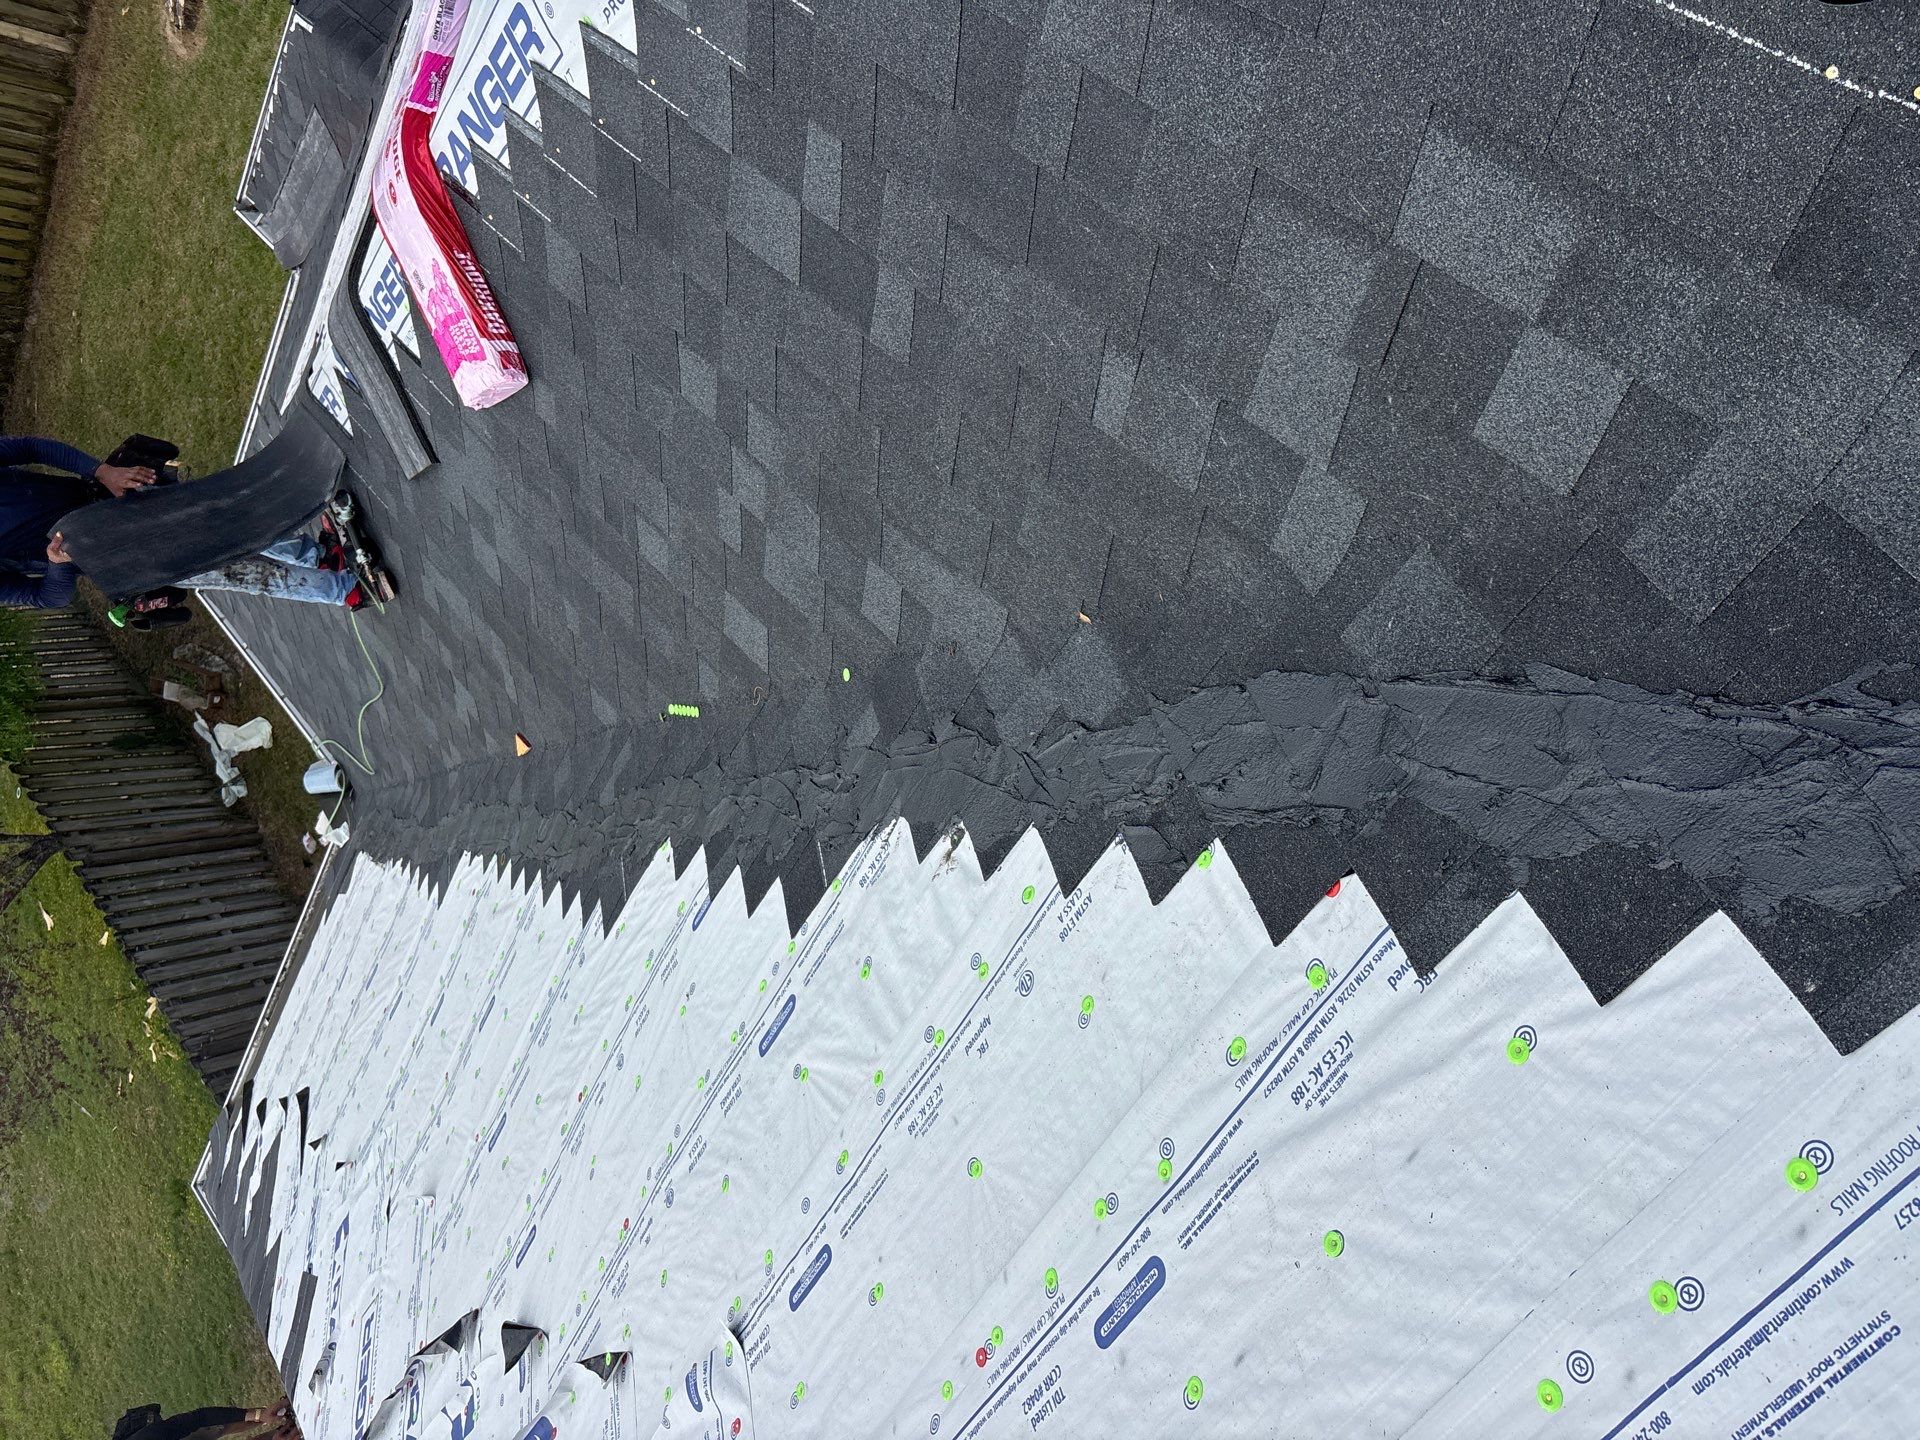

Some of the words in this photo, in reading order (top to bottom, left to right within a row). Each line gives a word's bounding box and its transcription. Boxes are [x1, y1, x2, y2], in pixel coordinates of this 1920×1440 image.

[435, 0, 445, 18] BLAC
[431, 19, 441, 40] ONYX
[1062, 887, 1083, 916] CLASS
[1073, 892, 1094, 921] ASTM
[1026, 910, 1048, 940] conditions
[1057, 912, 1065, 923] A
[1057, 916, 1076, 943] E108
[1371, 934, 1396, 967] Meets
[1353, 959, 1375, 988] ASTM
[1387, 955, 1415, 991] oved
[1298, 995, 1314, 1017] CAP
[1335, 980, 1357, 1008] D226,
[1279, 1009, 1302, 1039] NAILS
[1318, 1001, 1339, 1029] ASTM
[962, 1013, 992, 1055] Approved
[975, 1038, 989, 1059] FBC
[1300, 1023, 1322, 1051] D4869
[1248, 1035, 1279, 1073] ROOFING
[1321, 1028, 1354, 1070] ICC-ES
[1233, 1065, 1253, 1092] NAILS
[1279, 1051, 1299, 1077] ASTM
[1311, 1048, 1353, 1101] REQUIREMENTS
[923, 1081, 943, 1110] ICC-ES
[1261, 1071, 1283, 1099] D8257
[1289, 1061, 1325, 1107] AC-188
[1329, 1069, 1348, 1094] MEETS
[1303, 1096, 1314, 1111] OF
[1317, 1089, 1332, 1108] THE
[905, 1106, 927, 1136] AC-188
[1161, 1116, 1245, 1218] www.continentalmaterials.com
[1226, 1147, 1257, 1185] SYNTHETIC
[1859, 1131, 1920, 1189] ROOFING
[1212, 1180, 1229, 1202] ROOF
[1220, 1156, 1259, 1204] CONTINENTAL
[1825, 1175, 1870, 1218] NAILS
[1175, 1196, 1215, 1245] UNDERLAYMENT
[1190, 1200, 1222, 1239] MATERIALS,
[1889, 1195, 1920, 1231] 8257
[1114, 1226, 1152, 1272] 800-247-6637
[1180, 1236, 1192, 1251] INC.
[1044, 1292, 1066, 1319] PLASTIC
[1076, 1294, 1092, 1315] aware
[1090, 1286, 1101, 1300] Be
[1112, 1277, 1138, 1309] APPROVED
[1033, 1313, 1047, 1332] CAP
[1057, 1321, 1068, 1337] slip
[1066, 1311, 1079, 1328] that
[1100, 1304, 1126, 1337] COUNTY
[1685, 1254, 1859, 1398] www.continentalmaterials.com
[1019, 1325, 1036, 1348] NAILS
[1036, 1332, 1060, 1362] resistance
[1830, 1308, 1892, 1362] SYNTHETIC
[1024, 1356, 1037, 1374] may
[1802, 1354, 1836, 1385] ROOF
[1820, 1322, 1903, 1392] CONTINENTAL
[354, 1311, 375, 1440] GER
[984, 1366, 1001, 1388] NAILS
[1013, 1368, 1027, 1386] vary
[1041, 1363, 1062, 1391] CCRR
[990, 1380, 1017, 1414] dependent
[1020, 1383, 1045, 1415] #0482
[1049, 1385, 1066, 1407] TDI
[1028, 1398, 1053, 1431] Listed
[1758, 1383, 1827, 1440] MATERIALS,
